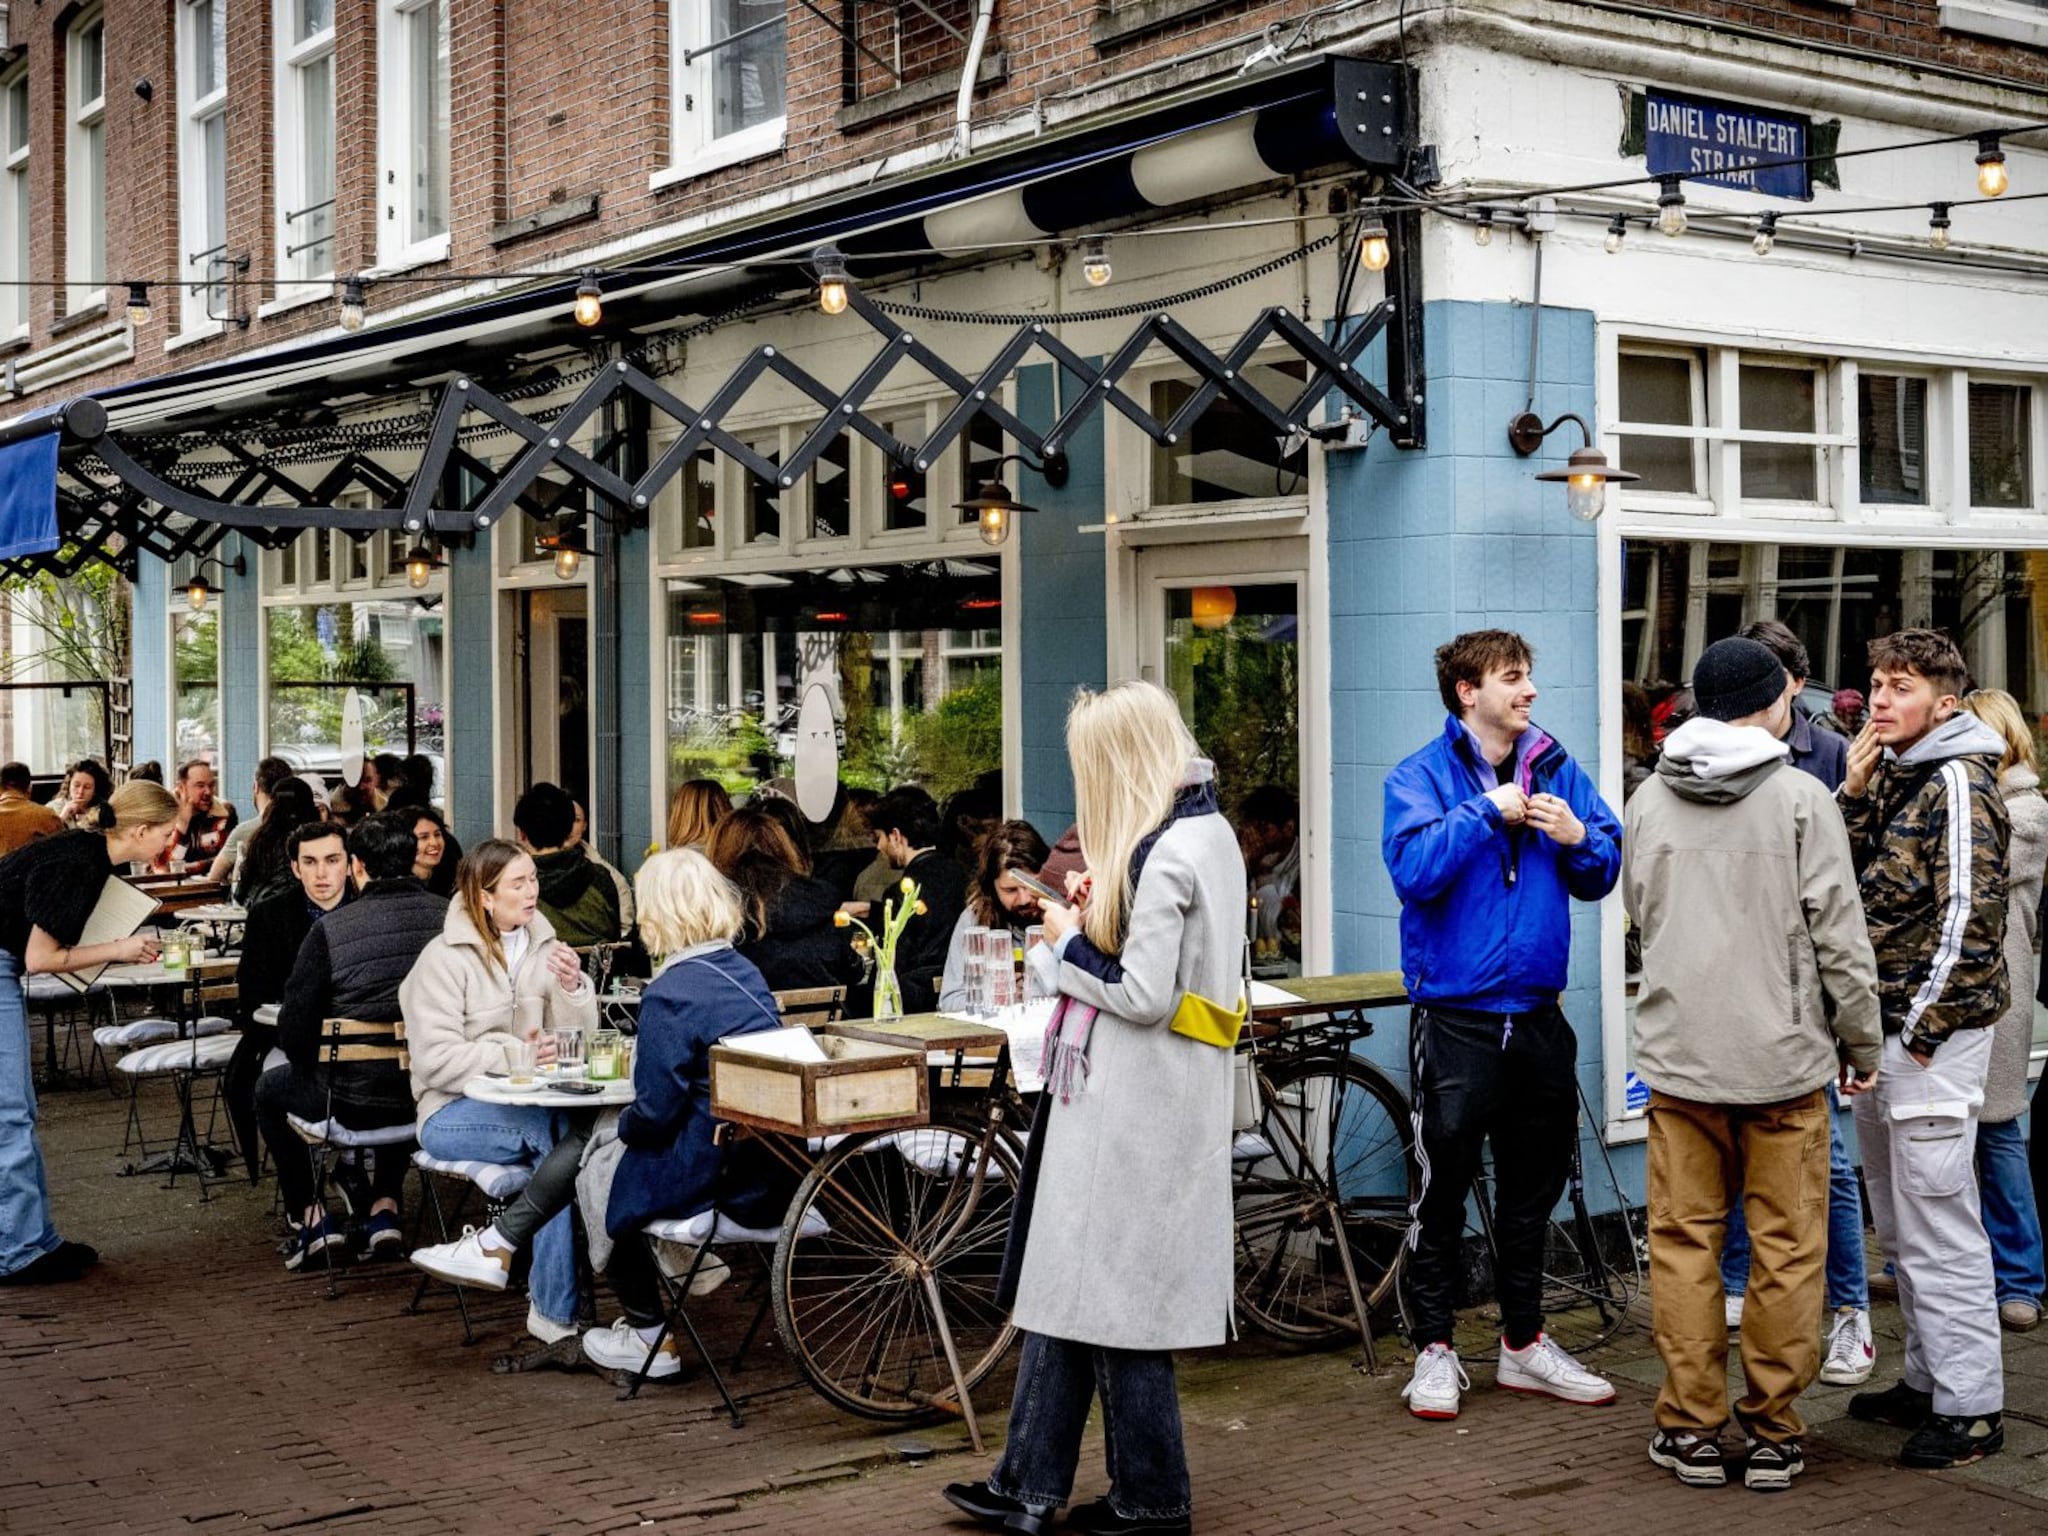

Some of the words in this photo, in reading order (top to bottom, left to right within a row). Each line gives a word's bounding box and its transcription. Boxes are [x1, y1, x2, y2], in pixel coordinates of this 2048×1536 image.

[1647, 102, 1709, 140] DANIEL
[1716, 113, 1798, 156] STALPERT
[1690, 148, 1758, 185] STRAAT
